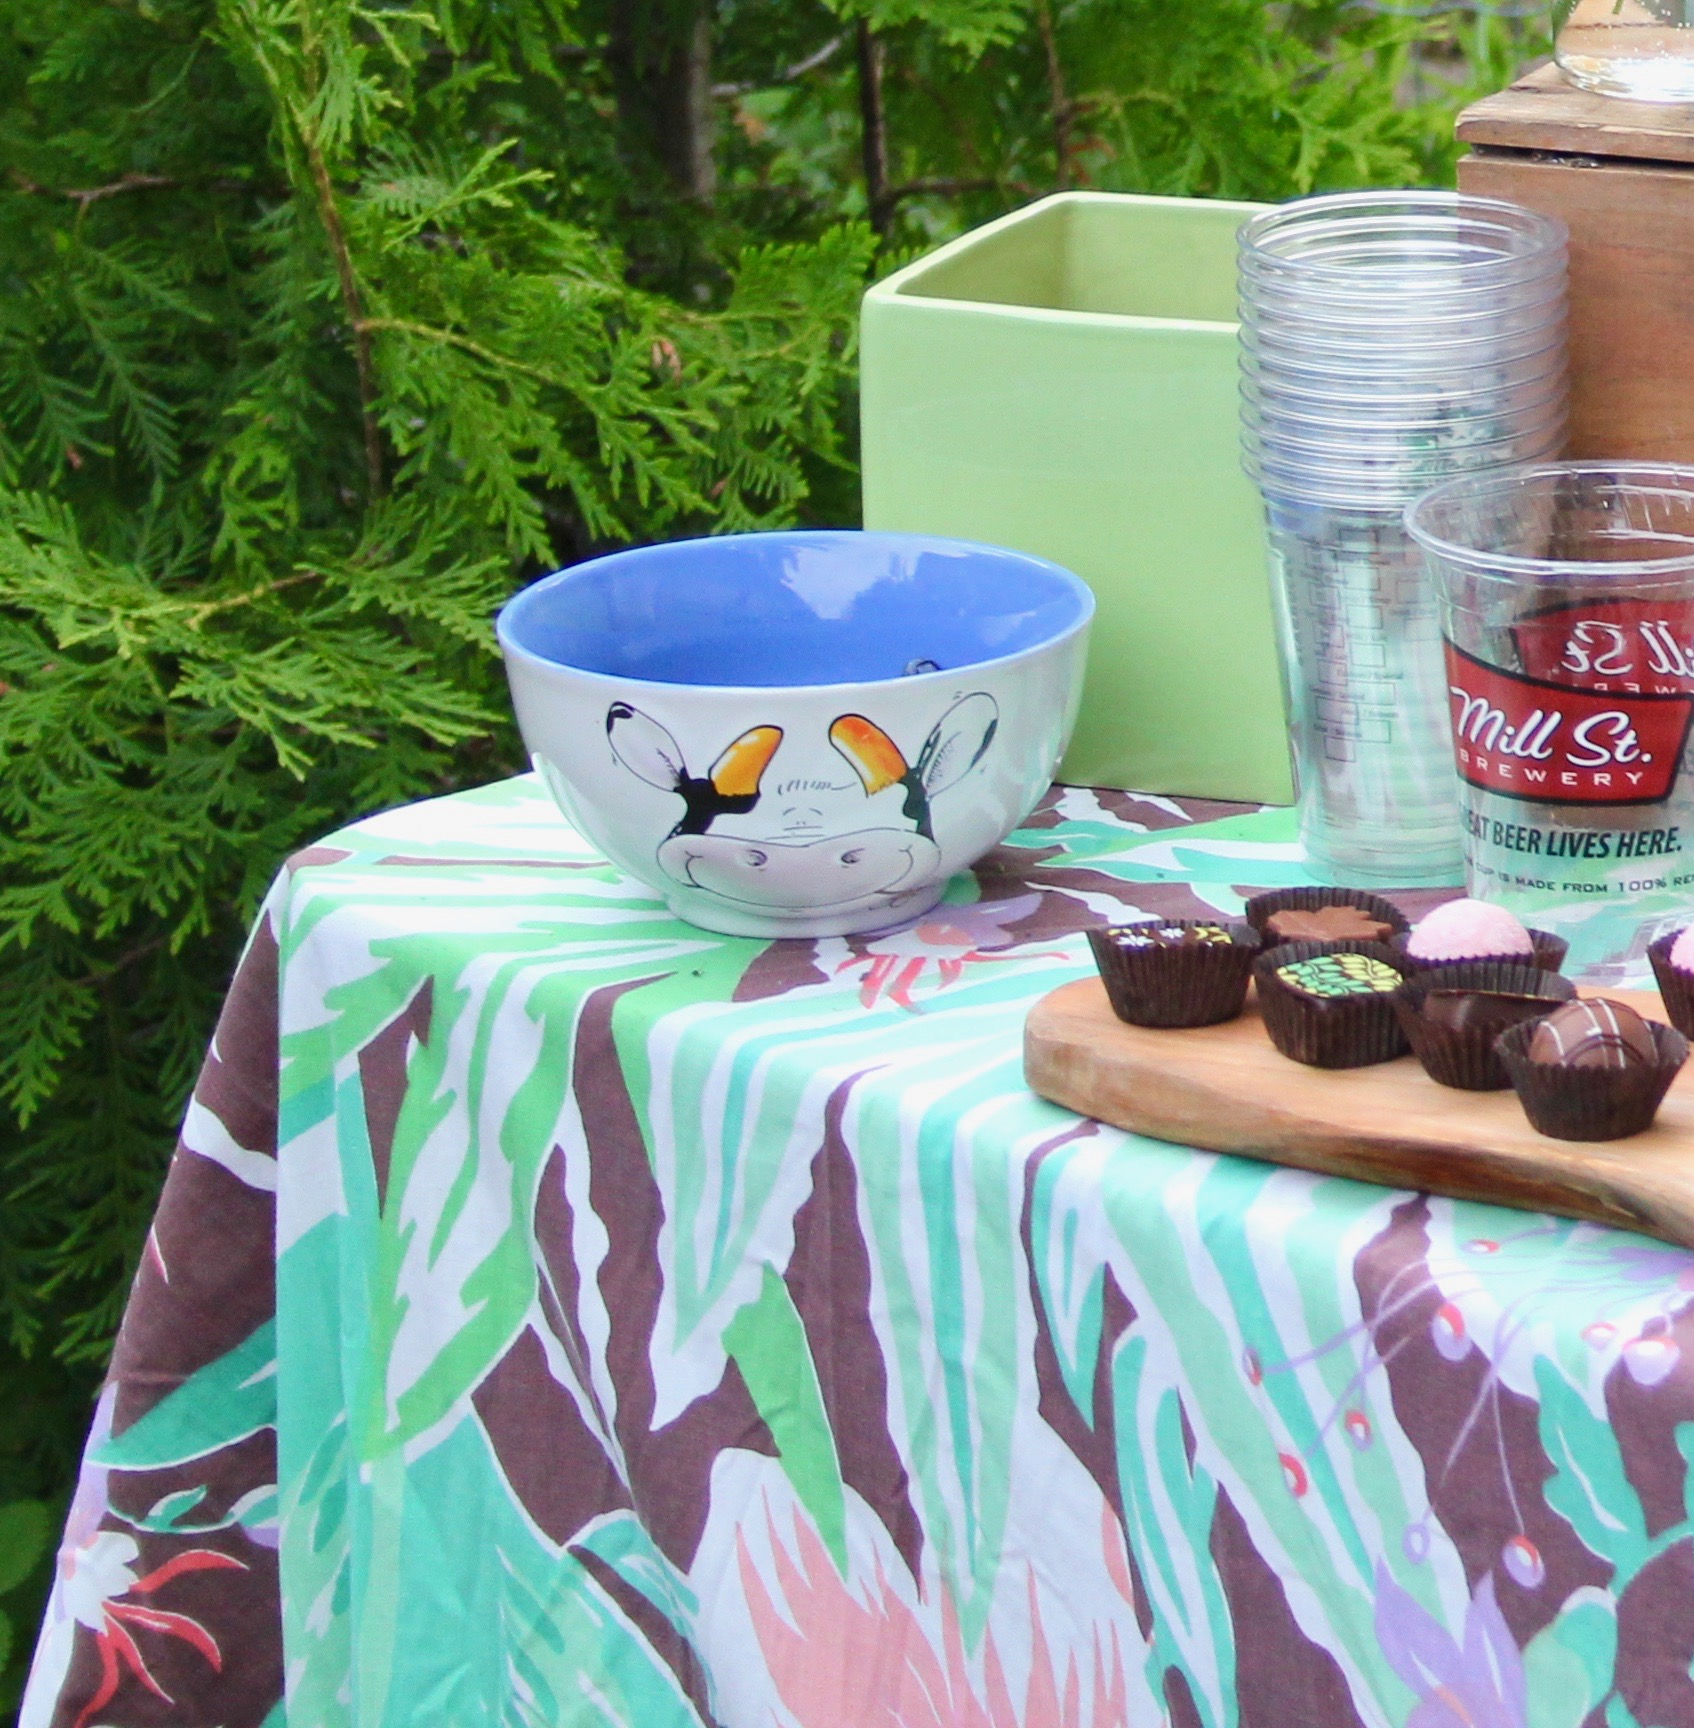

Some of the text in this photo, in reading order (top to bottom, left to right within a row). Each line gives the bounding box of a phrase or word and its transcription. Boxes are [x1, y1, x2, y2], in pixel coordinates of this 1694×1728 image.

[1449, 685, 1653, 767] Mill St.
[1458, 747, 1645, 786] BREWERY
[1493, 818, 1542, 855] BEER
[1546, 828, 1612, 859] LIVES
[1615, 825, 1683, 859] HERE.
[1515, 875, 1556, 892] MADE
[1562, 882, 1609, 894] FROM
[1617, 877, 1668, 894] 100%
